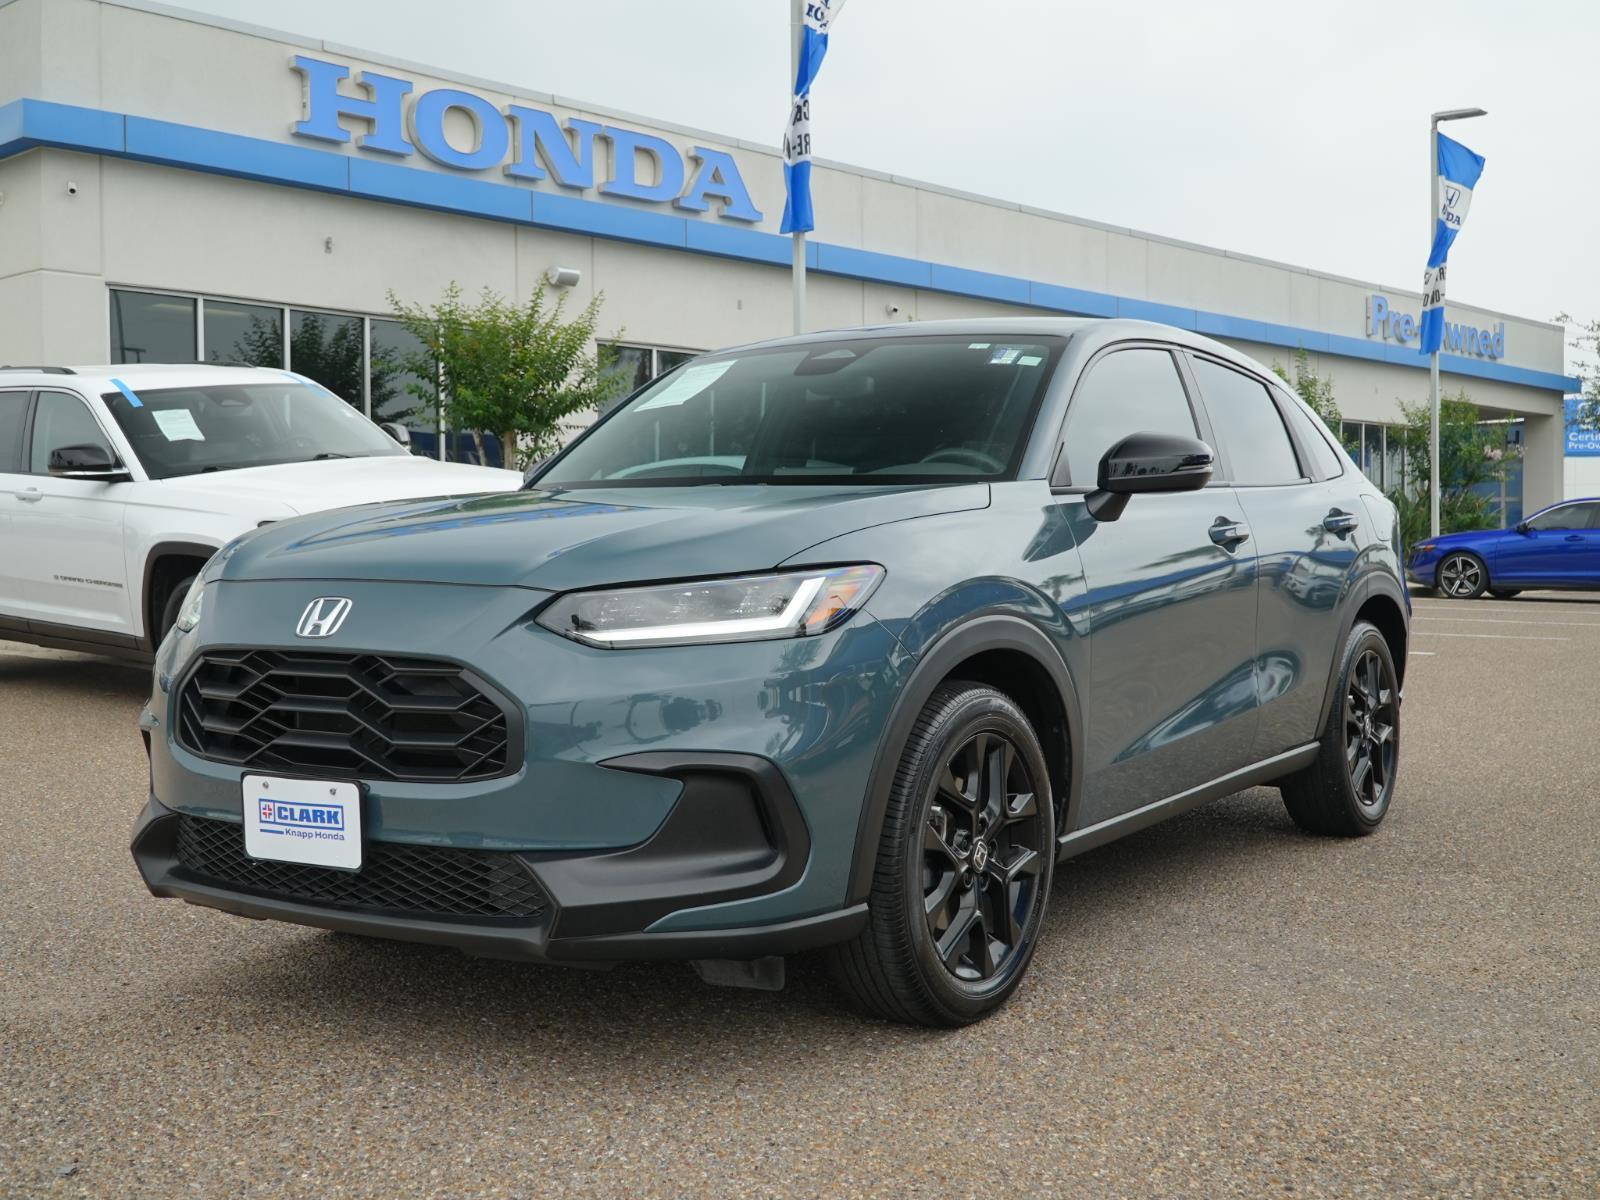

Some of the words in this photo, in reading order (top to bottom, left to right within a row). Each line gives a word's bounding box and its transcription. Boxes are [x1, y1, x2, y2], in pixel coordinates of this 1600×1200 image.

[289, 54, 763, 223] HONDA
[1367, 294, 1505, 359] Pre-wned
[277, 806, 340, 825] CLARK
[285, 828, 314, 839] Knapp
[315, 831, 345, 841] Honda
